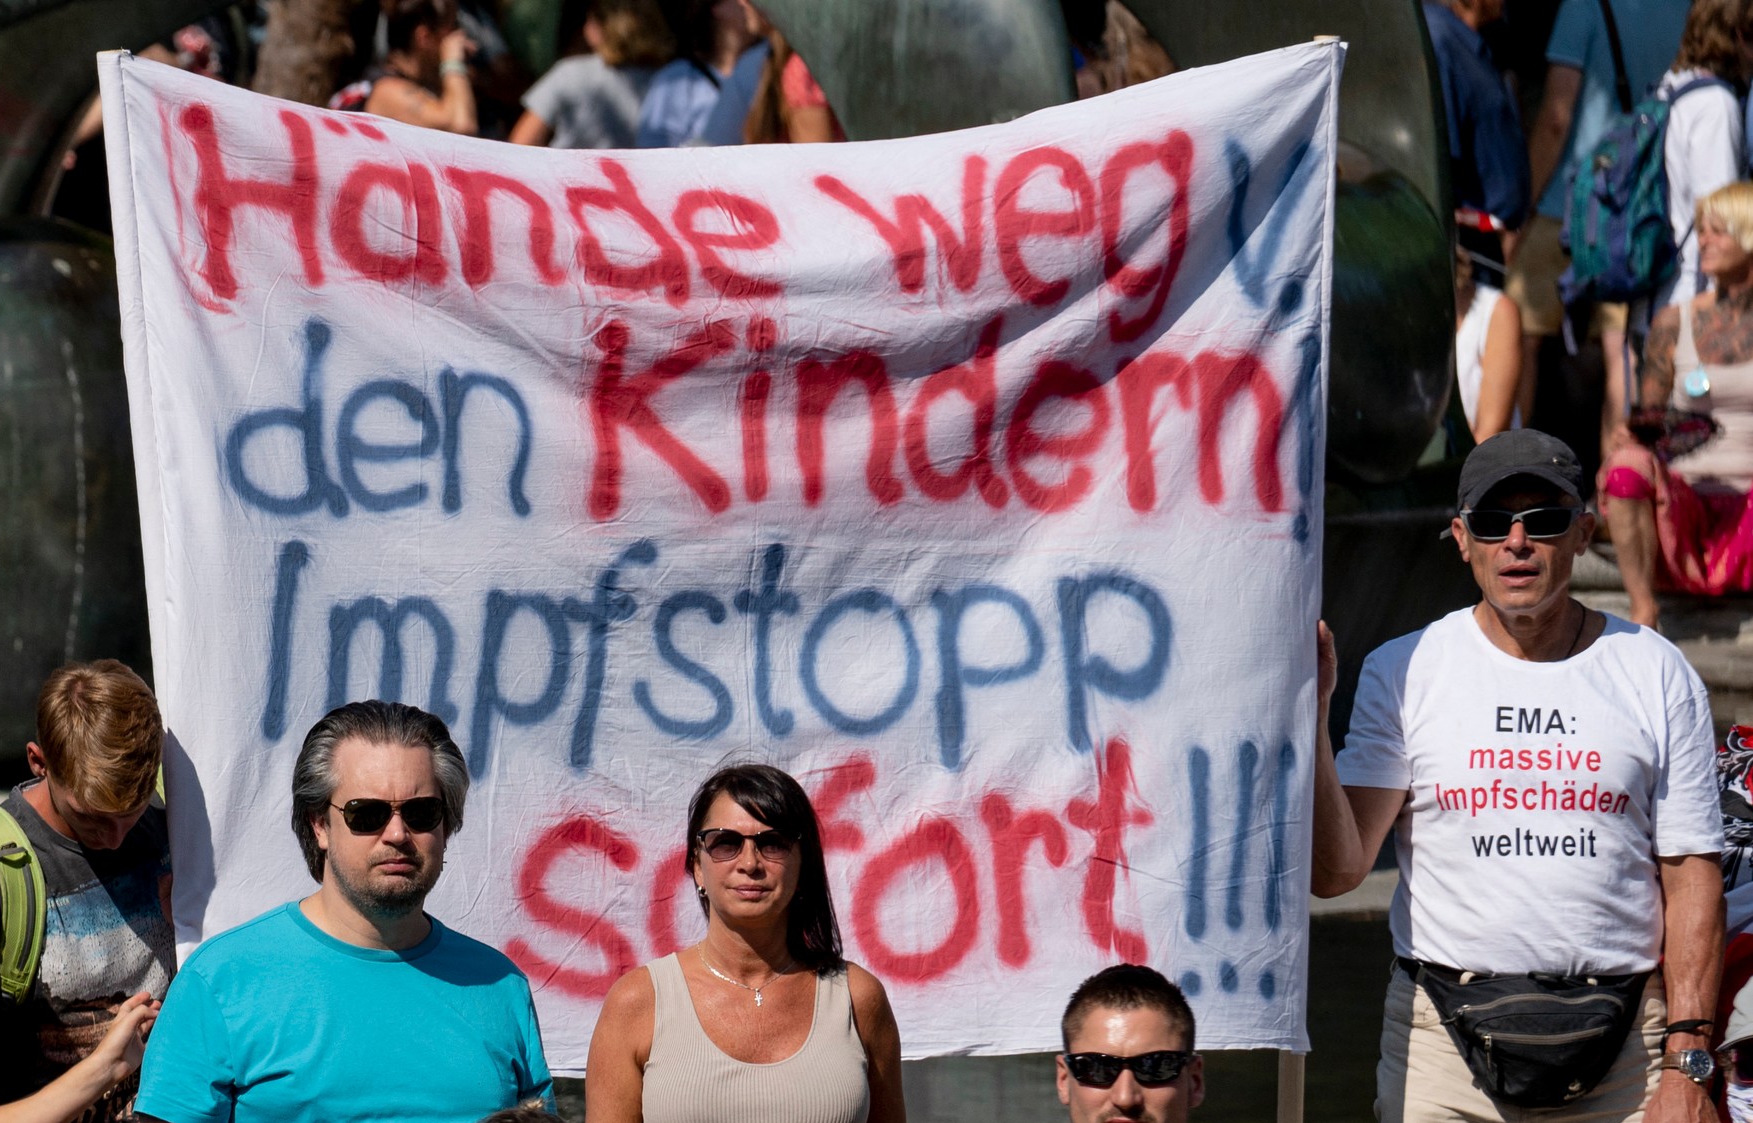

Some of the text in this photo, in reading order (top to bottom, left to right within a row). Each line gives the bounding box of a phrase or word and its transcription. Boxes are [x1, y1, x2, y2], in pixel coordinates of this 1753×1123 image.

[181, 102, 786, 308] Hände
[814, 127, 1192, 343] weg
[224, 316, 534, 520] den
[261, 536, 1174, 778] Impfstopp
[1494, 705, 1578, 736] EMA:
[1468, 743, 1602, 771] massive
[1436, 780, 1630, 817] Impfschäden
[1471, 827, 1598, 858] weltweit
